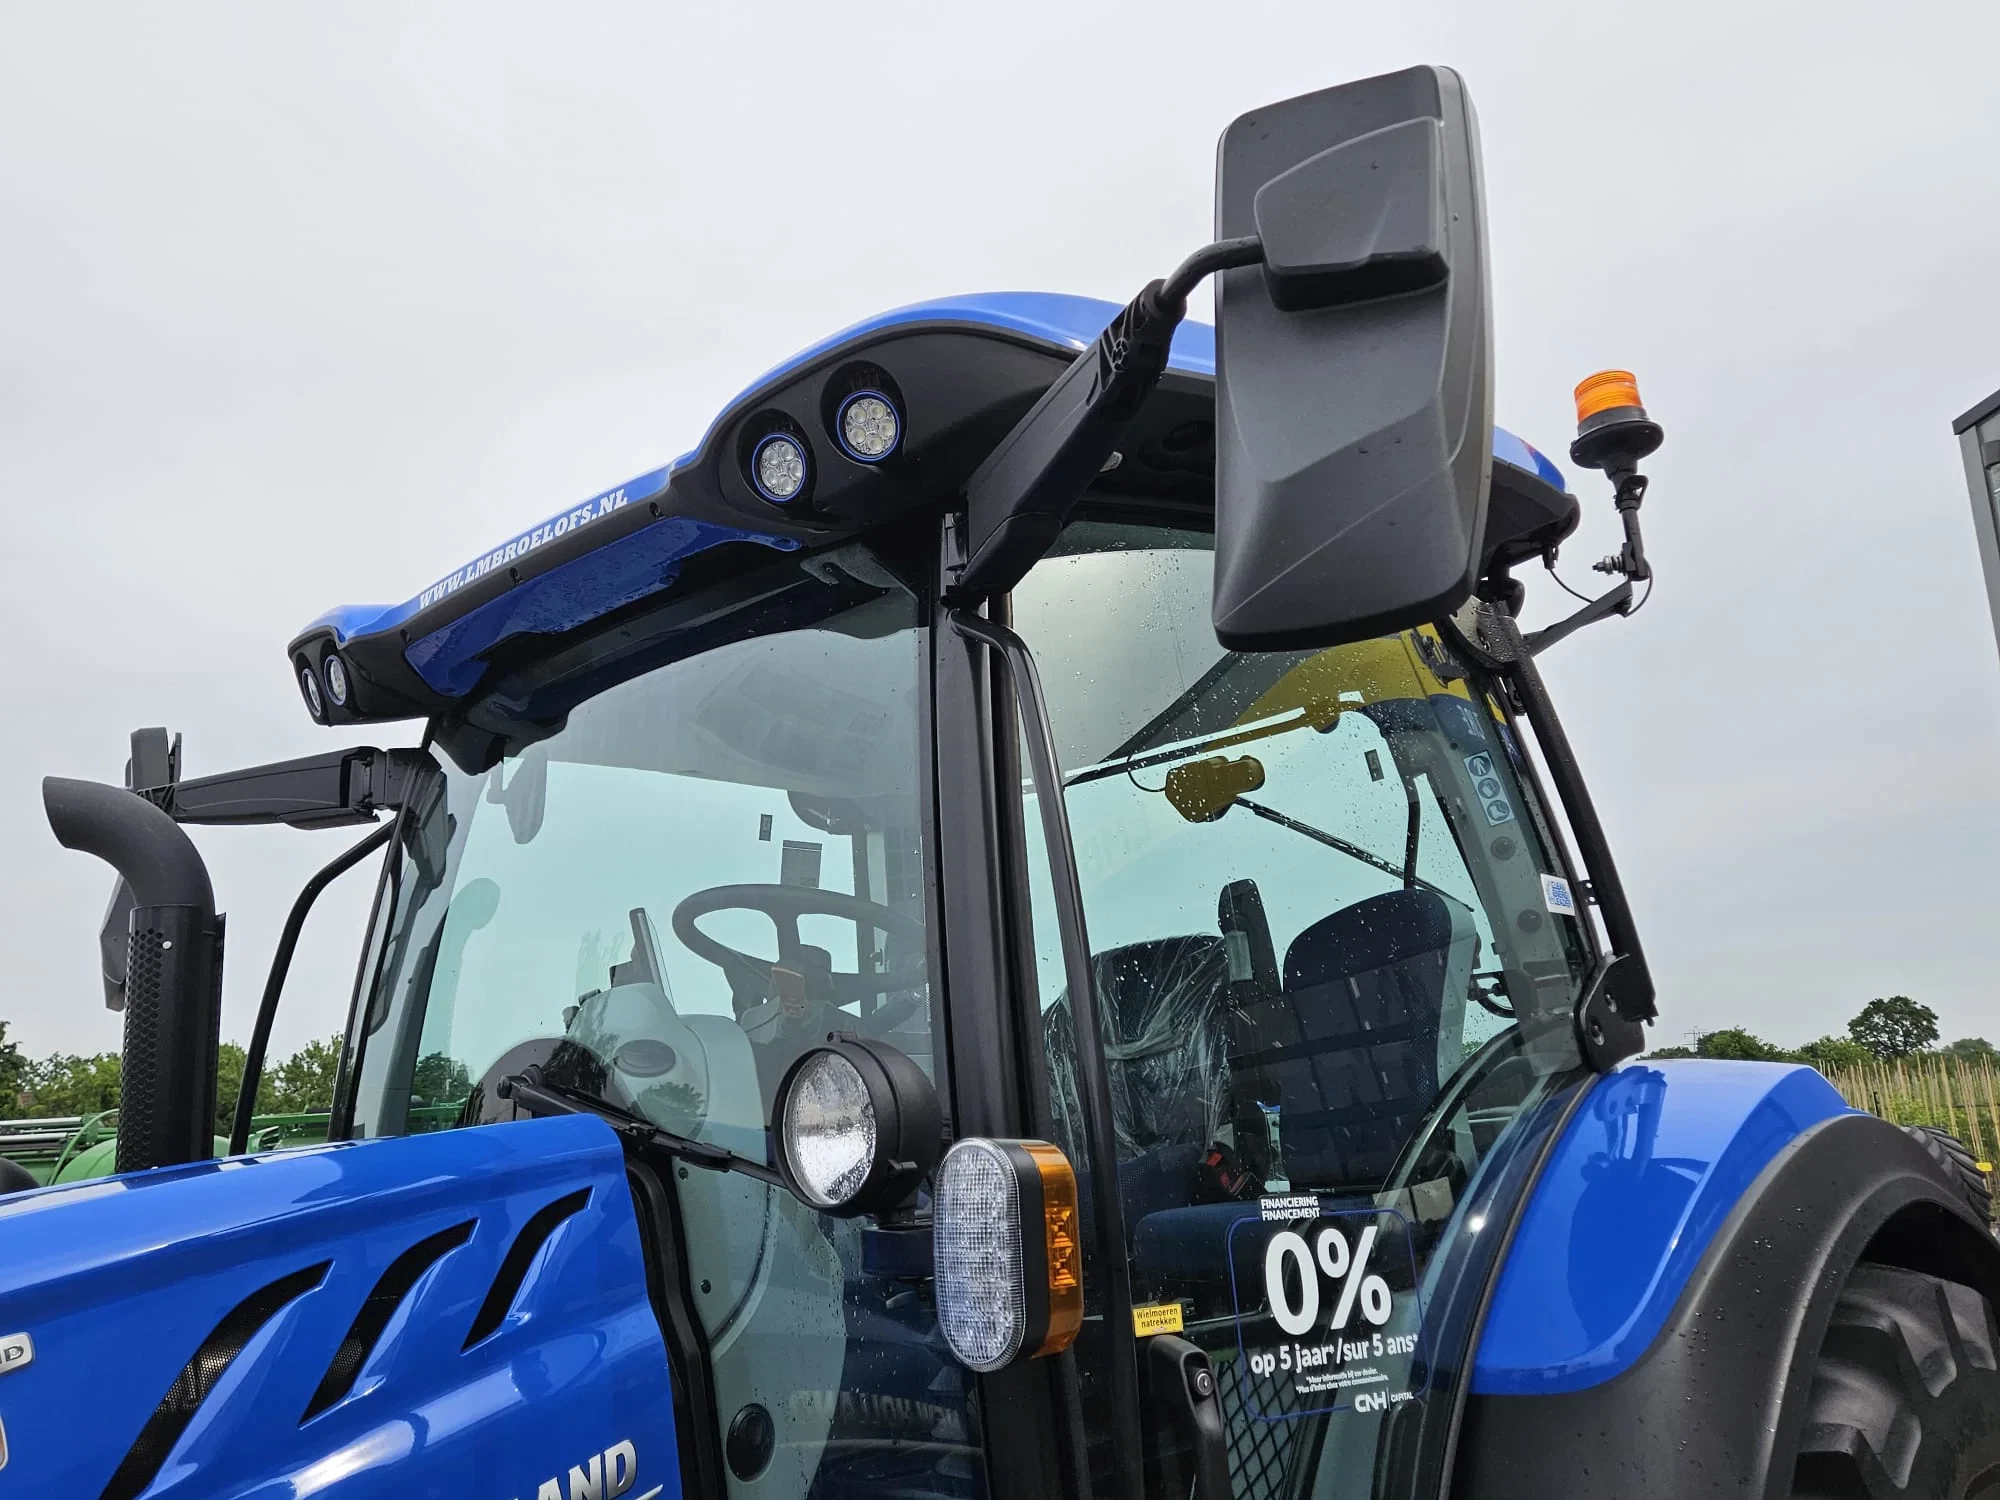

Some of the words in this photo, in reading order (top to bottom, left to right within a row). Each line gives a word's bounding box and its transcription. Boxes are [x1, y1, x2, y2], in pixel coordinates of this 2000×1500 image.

[418, 488, 629, 610] WWW.LMBROELOFS.NL
[1260, 1196, 1319, 1209] FINANCIERING
[1262, 1207, 1320, 1221] FINANCEMENT
[1265, 1225, 1392, 1335] 0%
[1136, 1307, 1178, 1319] Wielmoeren
[1141, 1317, 1177, 1328] natrekken
[1250, 1353, 1276, 1378] op
[1279, 1345, 1292, 1370] 5
[1372, 1333, 1383, 1357] 5
[1355, 1391, 1387, 1413] CNH
[1391, 1391, 1414, 1403] CAPITAL
